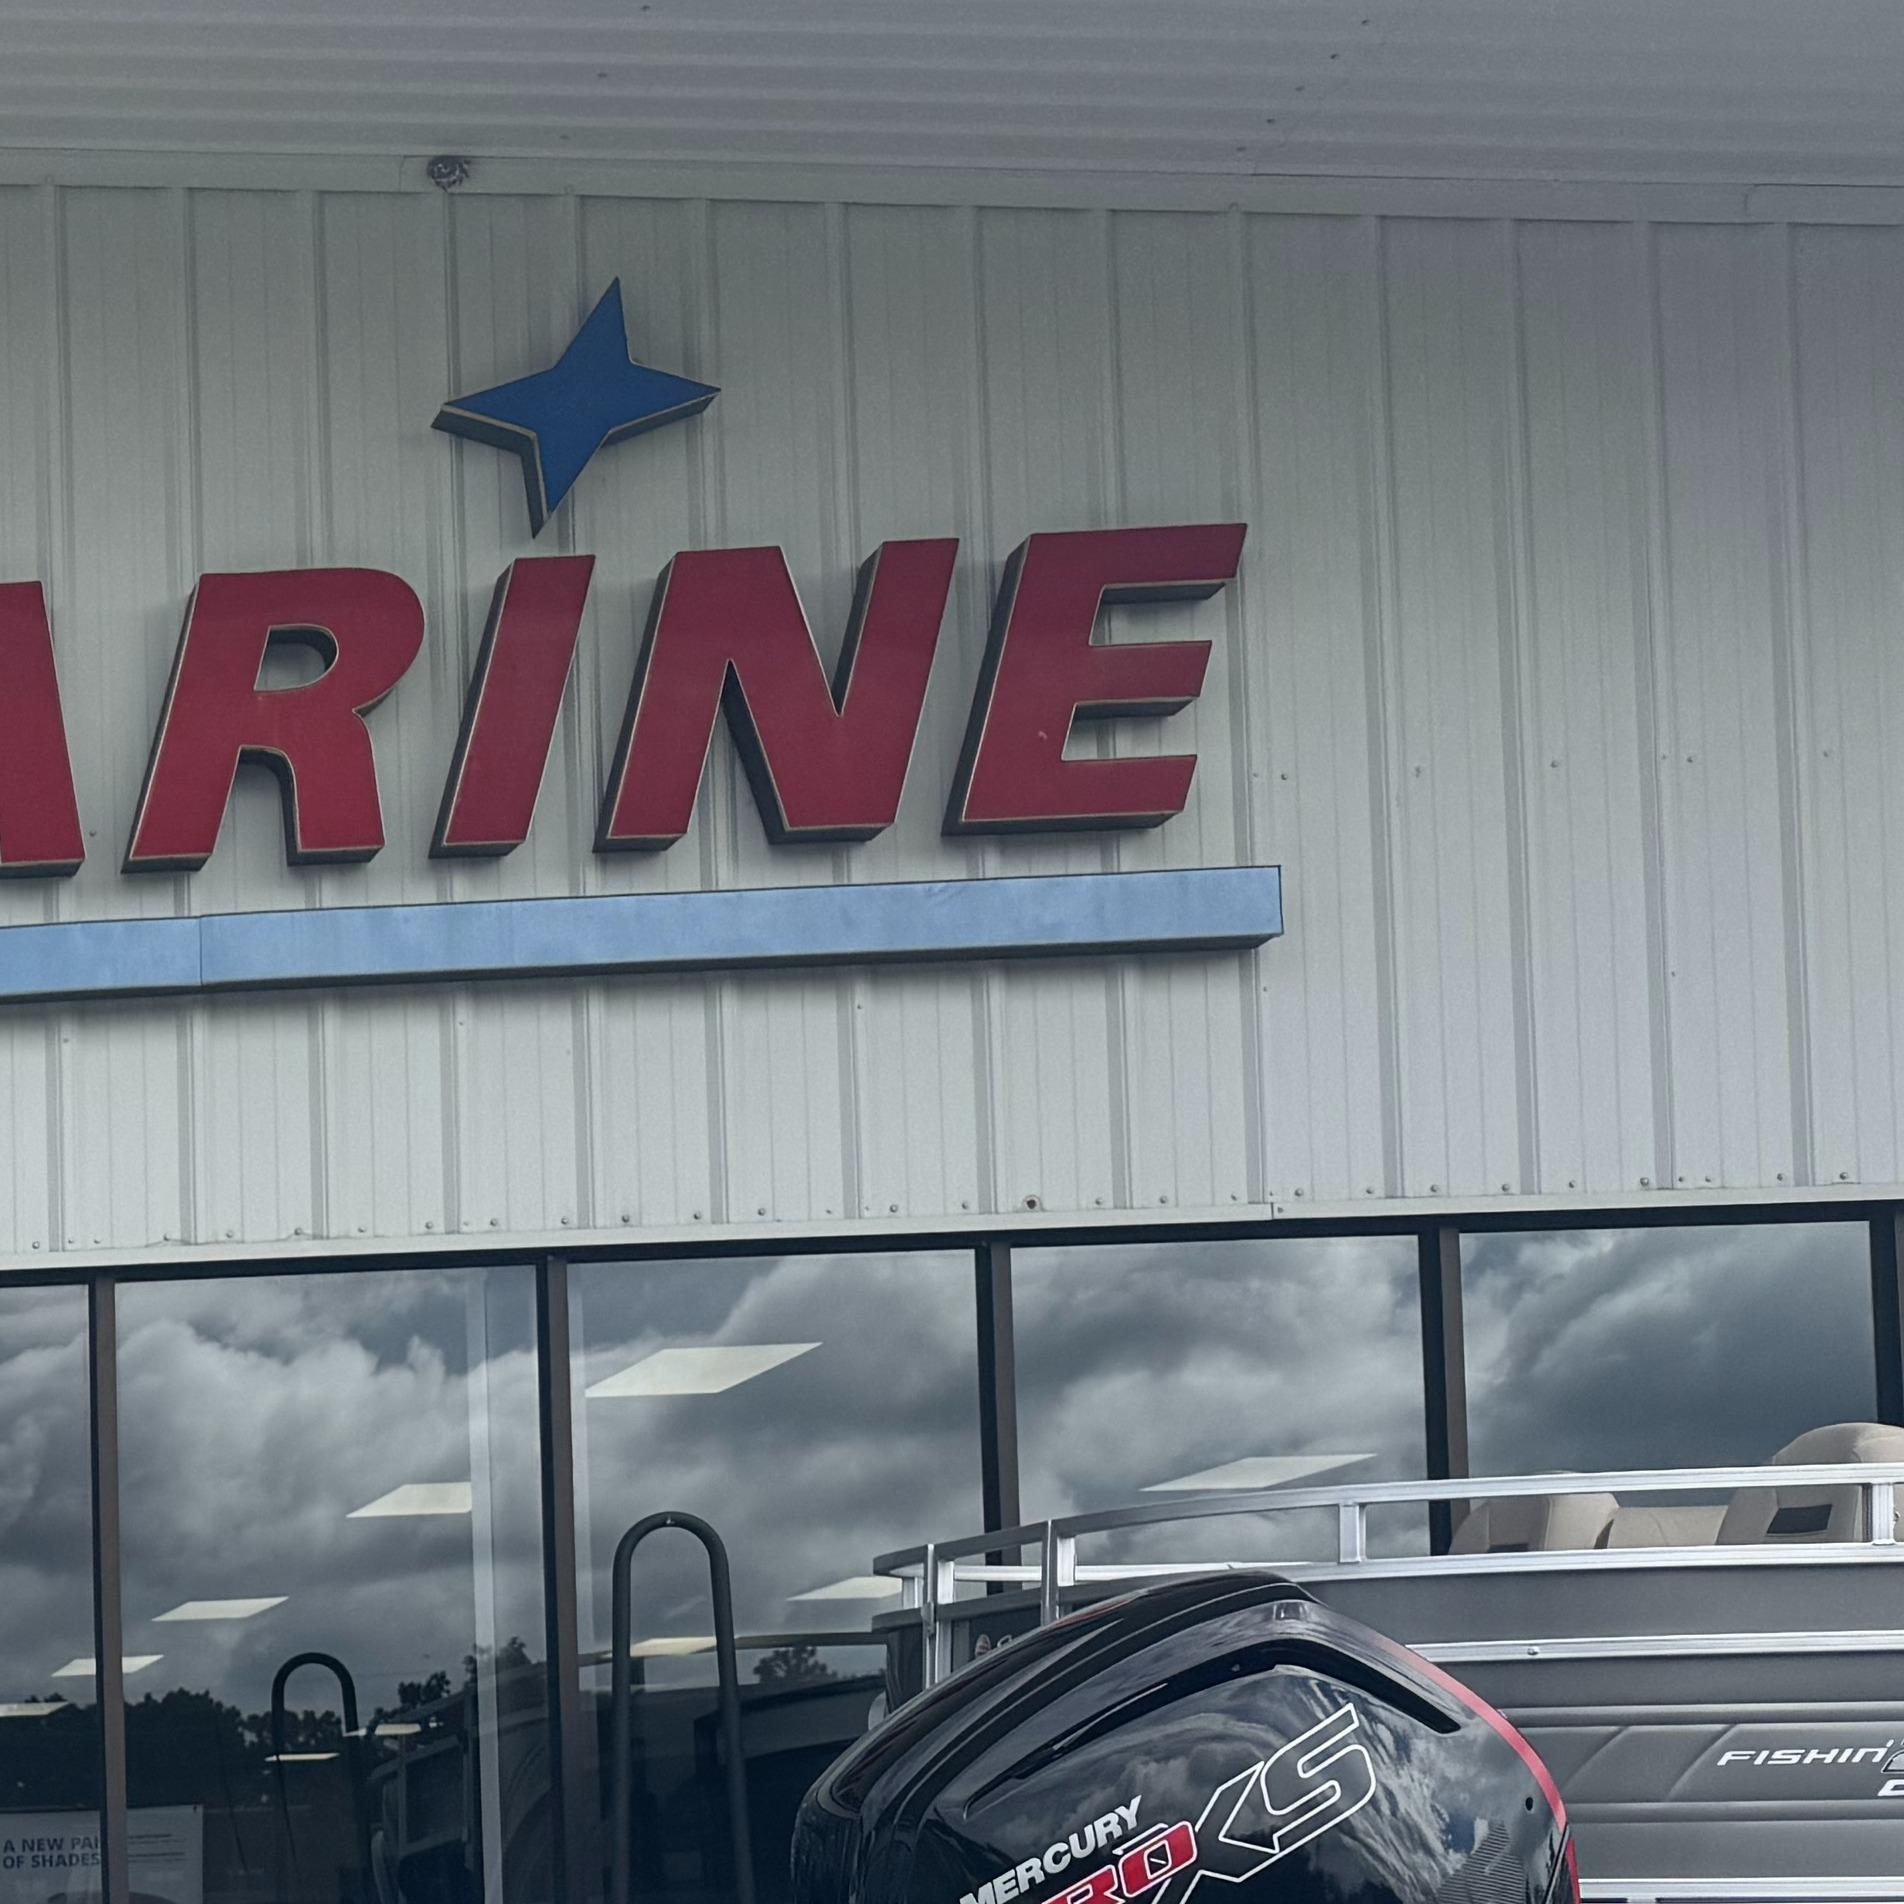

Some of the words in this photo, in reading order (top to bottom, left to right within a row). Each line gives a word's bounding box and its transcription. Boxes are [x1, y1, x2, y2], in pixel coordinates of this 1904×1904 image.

[1716, 1738, 1895, 1767] FISHIN'
[3, 1839, 16, 1853] A
[22, 1838, 64, 1852] NEW
[3, 1856, 25, 1869] OF
[30, 1853, 101, 1868] SHADES
